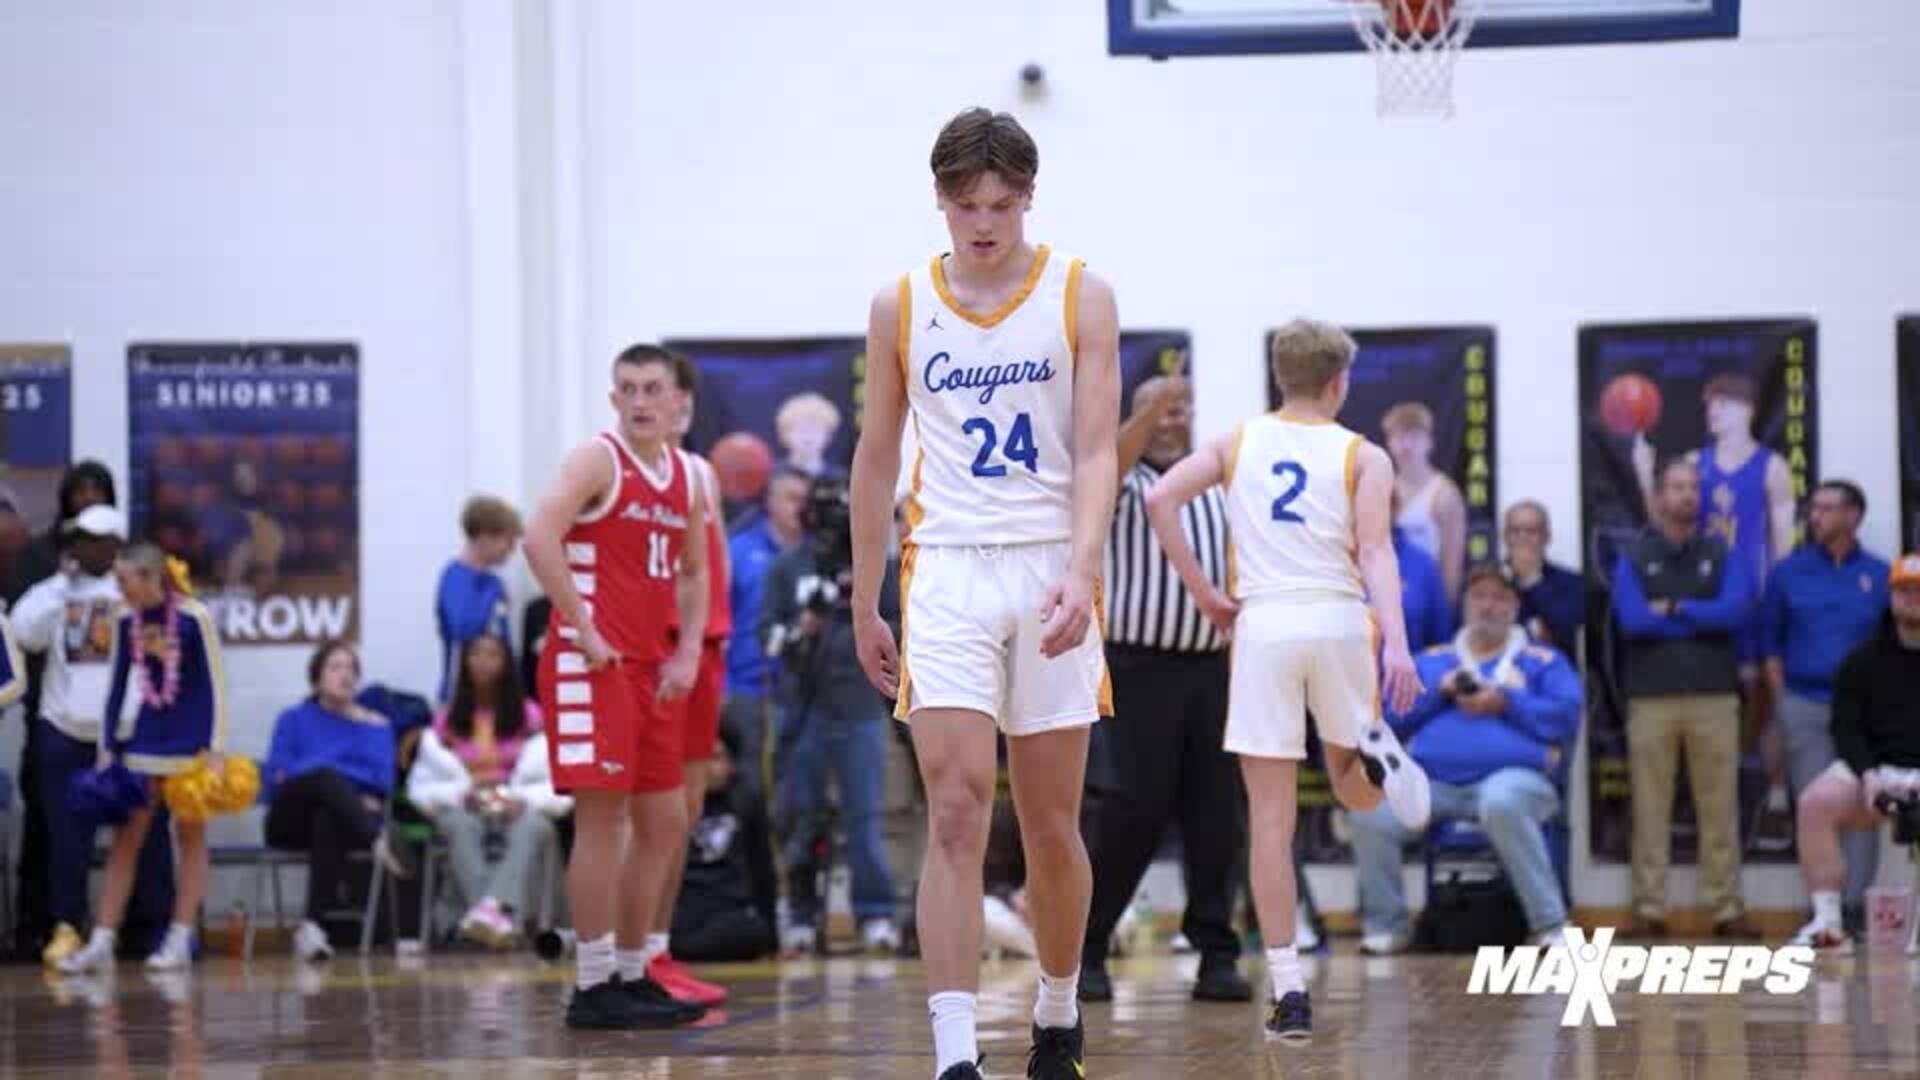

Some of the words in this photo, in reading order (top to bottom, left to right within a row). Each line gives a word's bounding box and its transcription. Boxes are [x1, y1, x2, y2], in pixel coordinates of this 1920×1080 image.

[923, 351, 1056, 404] Cougars
[961, 412, 1039, 478] 24
[1270, 460, 1308, 524] 2
